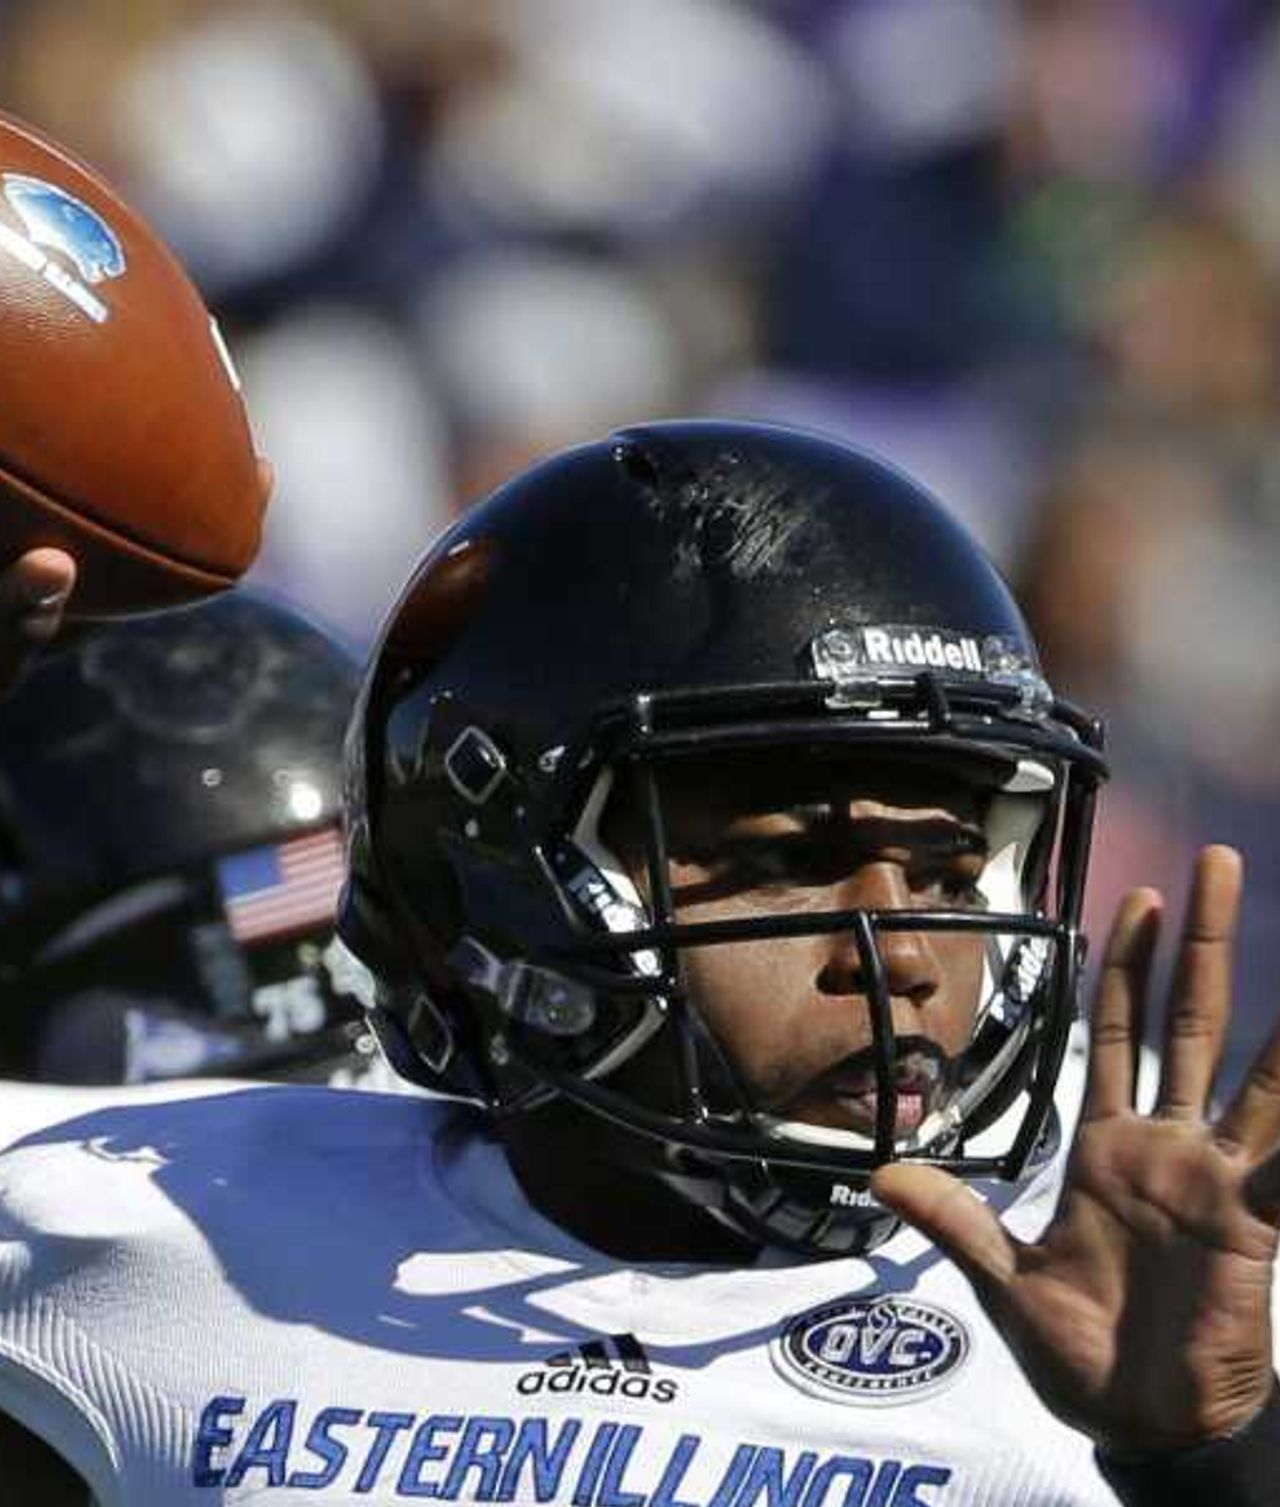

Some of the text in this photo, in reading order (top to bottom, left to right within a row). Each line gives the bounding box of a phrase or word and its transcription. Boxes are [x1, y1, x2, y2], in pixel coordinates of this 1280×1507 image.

[863, 628, 982, 672] Riddell
[820, 1323, 933, 1367] OVC
[517, 1364, 679, 1403] adidas
[193, 1395, 583, 1504] EASTERN
